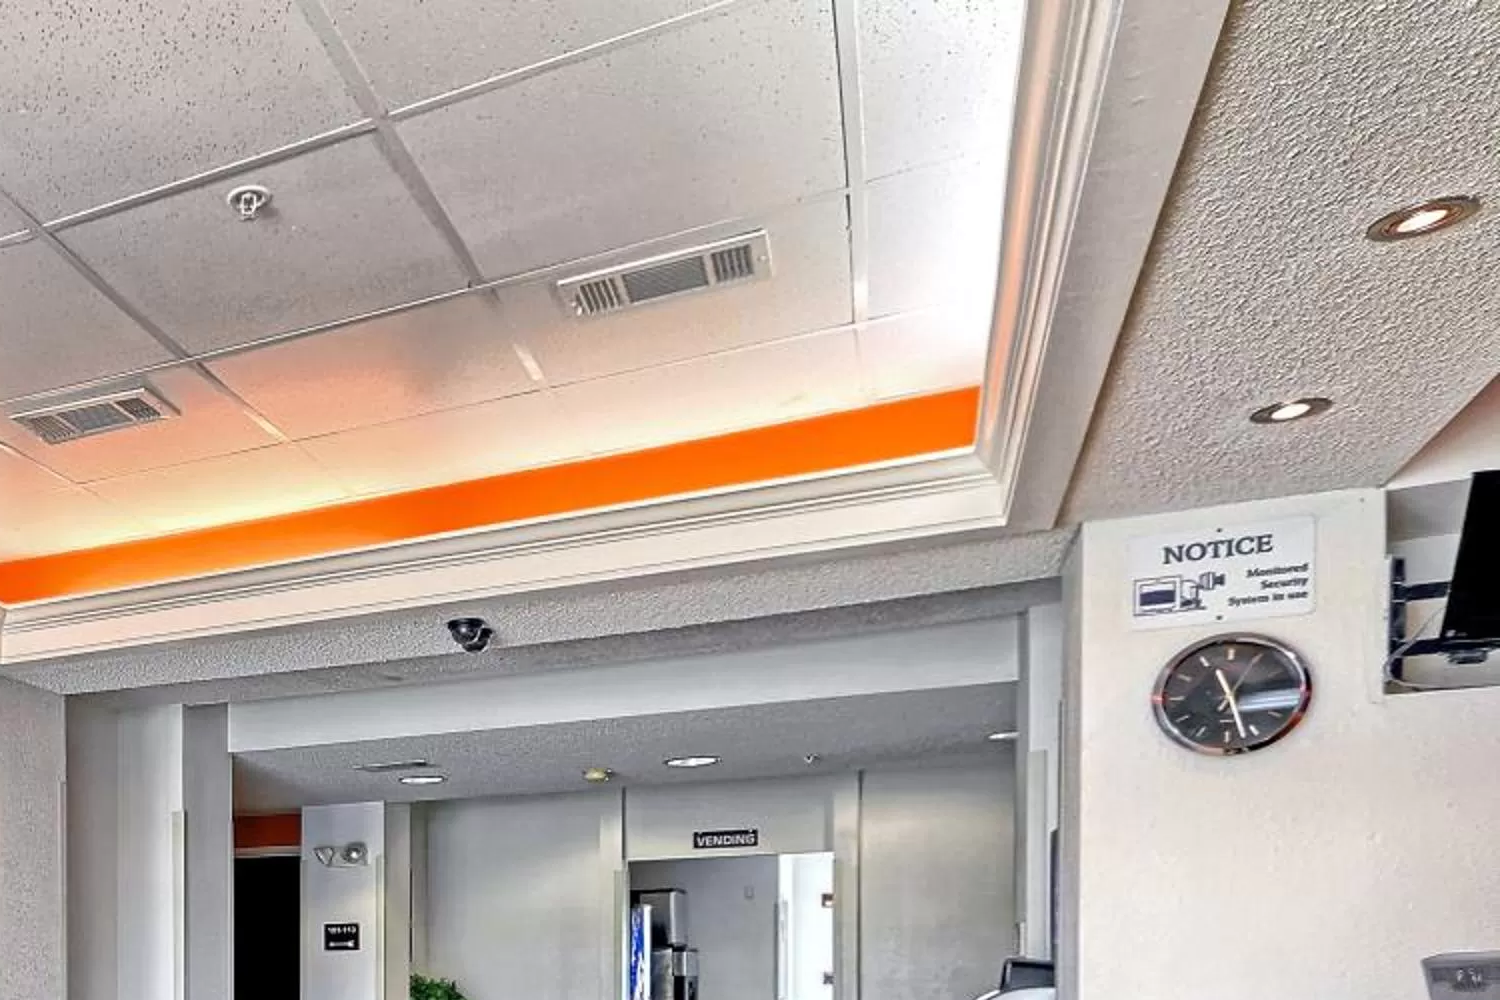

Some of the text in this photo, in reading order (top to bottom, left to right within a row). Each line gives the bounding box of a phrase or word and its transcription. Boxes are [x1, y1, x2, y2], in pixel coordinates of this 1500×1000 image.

[1162, 534, 1273, 564] NOTICE
[1246, 563, 1309, 578] Monitored
[1260, 577, 1309, 590] Security
[1228, 591, 1308, 607] System in use
[696, 833, 755, 847] VENDING
